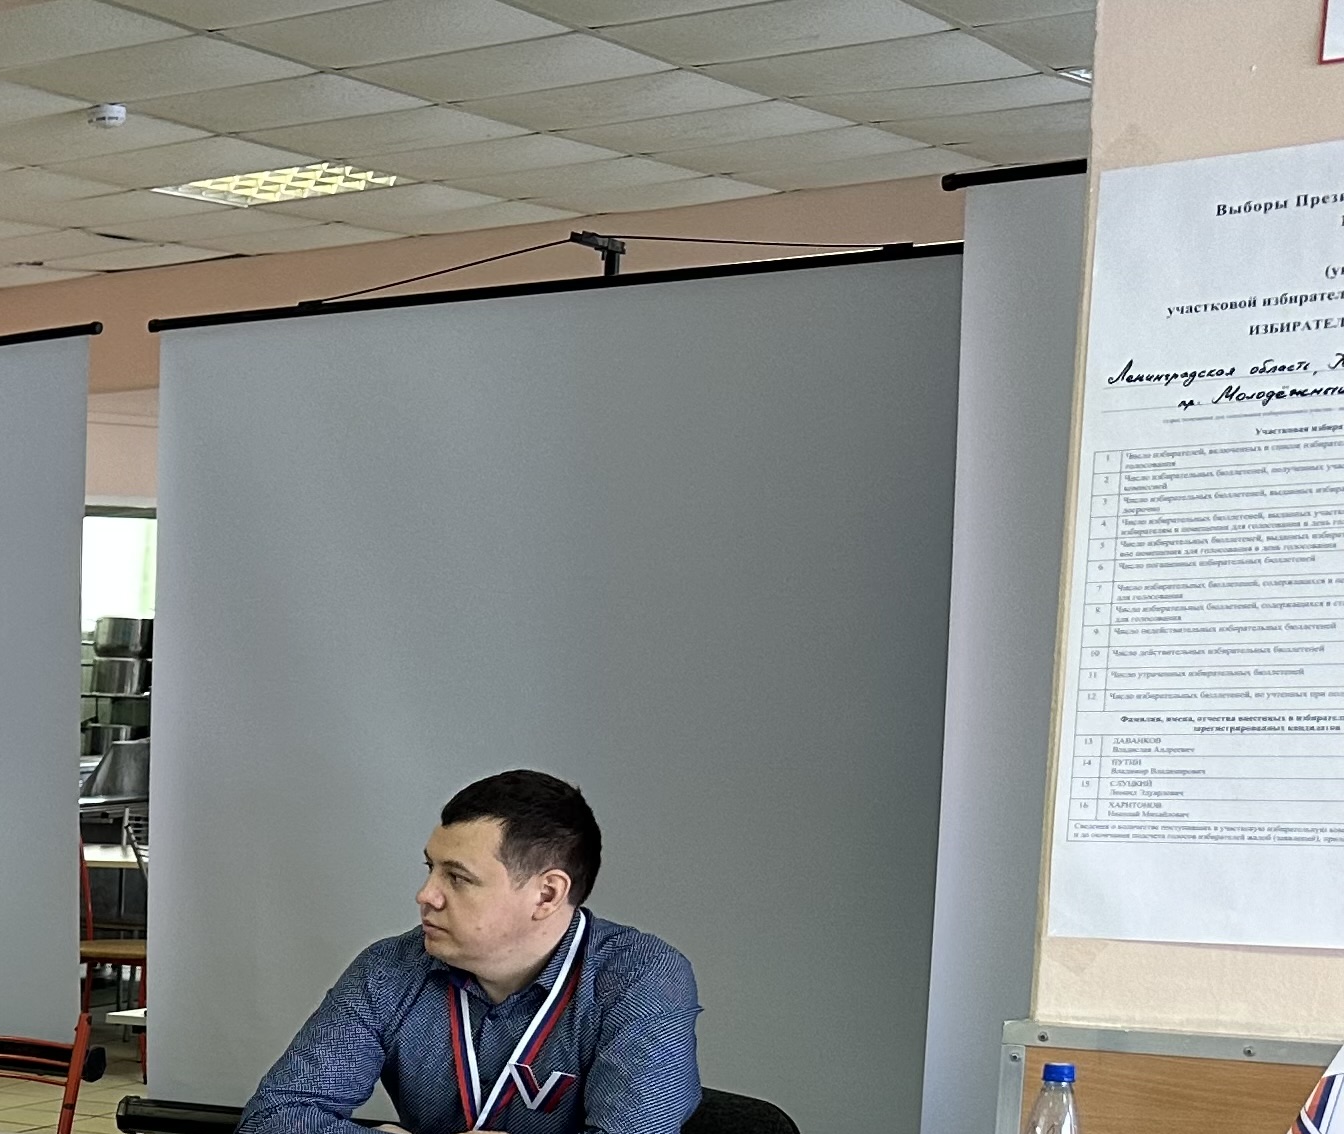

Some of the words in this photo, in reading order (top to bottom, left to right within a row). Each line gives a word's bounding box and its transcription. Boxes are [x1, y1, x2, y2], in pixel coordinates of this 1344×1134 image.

[1216, 199, 1289, 216] Выборы
[1166, 296, 1257, 319] участковой
[1108, 359, 1236, 387] Ленинградская
